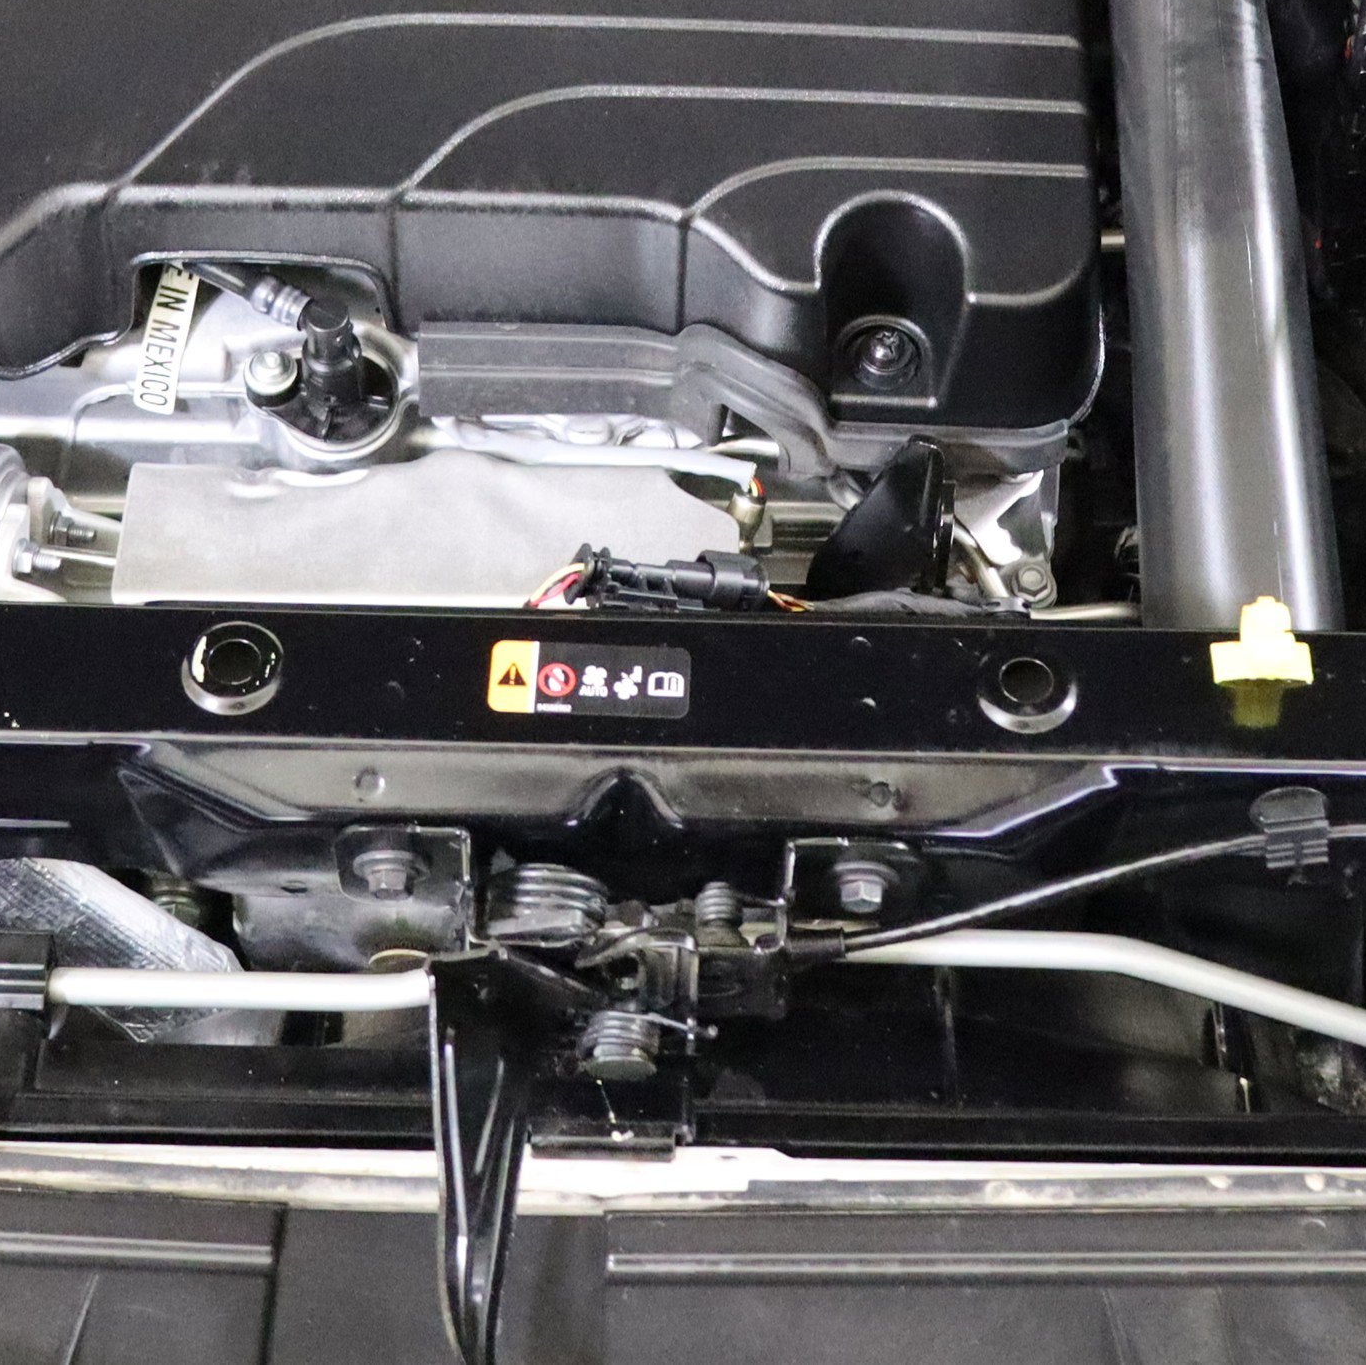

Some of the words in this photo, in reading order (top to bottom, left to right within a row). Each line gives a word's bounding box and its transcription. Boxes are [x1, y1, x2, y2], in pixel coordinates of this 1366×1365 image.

[156, 285, 189, 312] IN
[139, 319, 181, 407] MEXICO
[578, 685, 609, 698] AUTO
